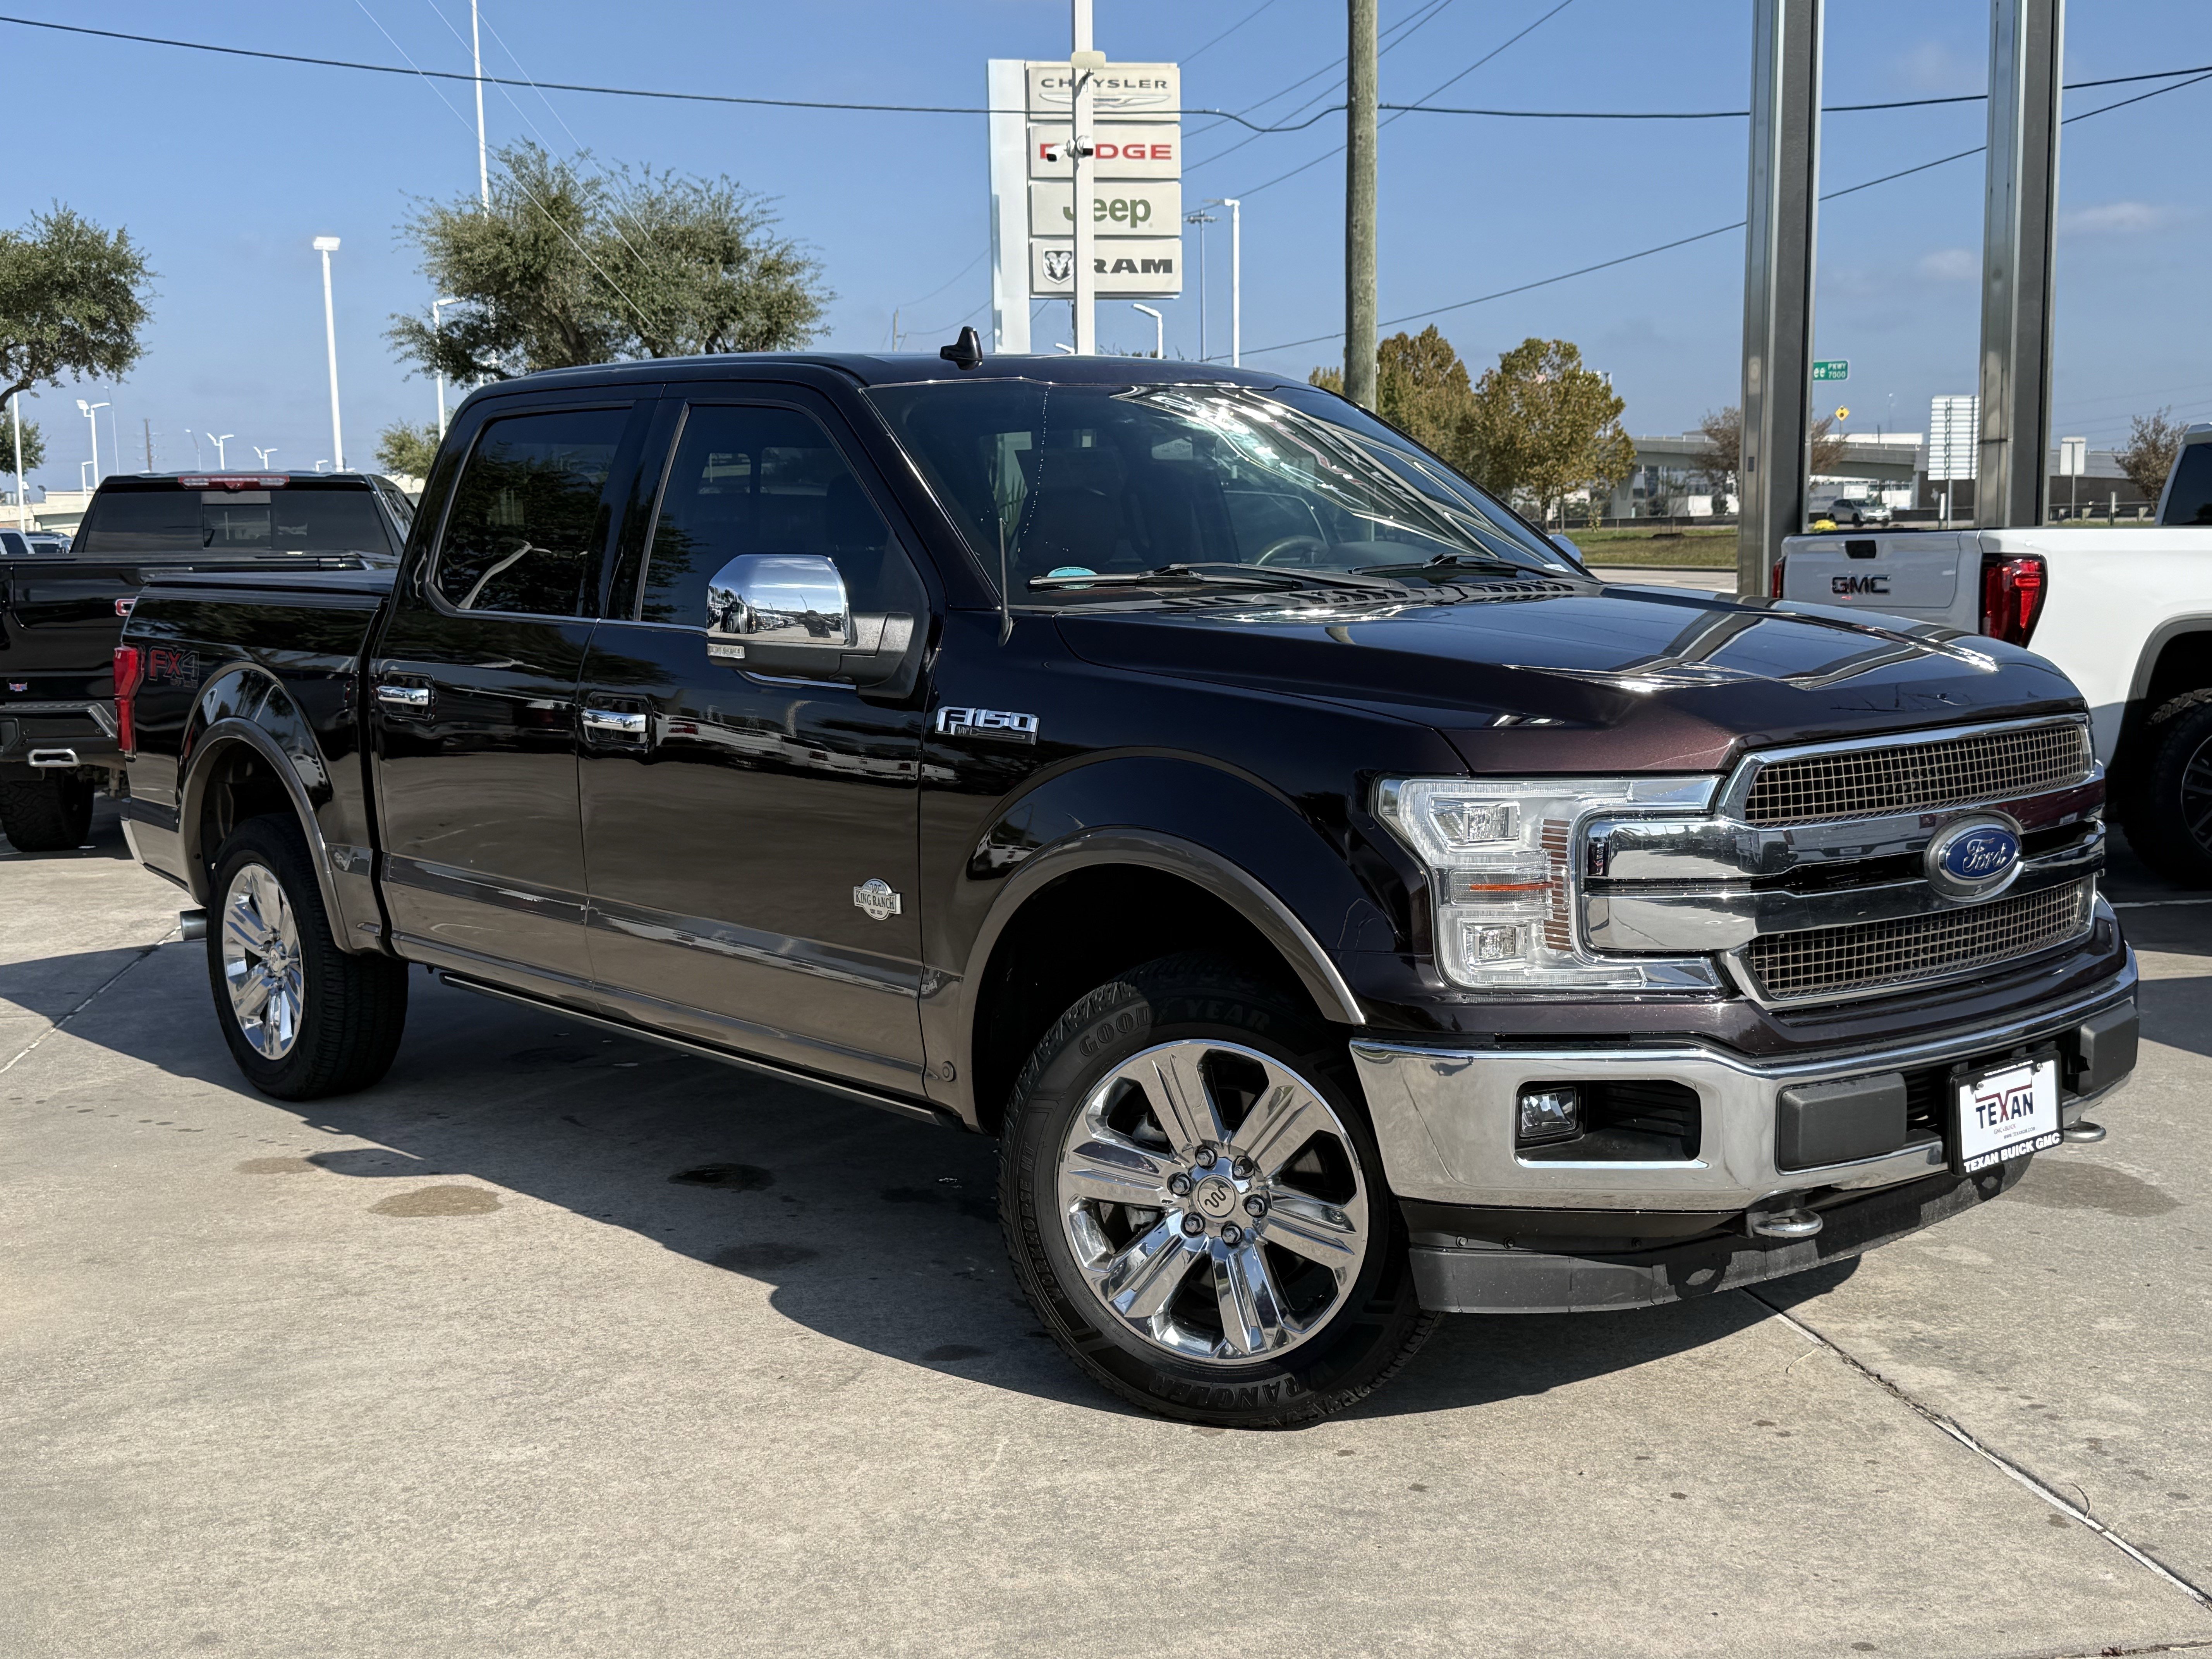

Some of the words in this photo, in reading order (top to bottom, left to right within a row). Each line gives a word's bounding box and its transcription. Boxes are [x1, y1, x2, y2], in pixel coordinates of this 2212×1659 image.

[1041, 78, 1168, 89] CHYSLER
[1040, 143, 1172, 160] DGE
[1832, 574, 1891, 595] GMC
[148, 646, 199, 682] FX4
[1962, 837, 2007, 873] Ford
[855, 890, 871, 905] KING
[872, 895, 895, 910] RANCH
[1975, 1085, 2033, 1129] TEXAN
[1964, 1152, 1999, 1173] TEXAN
[2001, 1140, 2034, 1161] BUICK
[2035, 1132, 2060, 1149] GMC
[1020, 1179, 1063, 1303] WORKHORSE
